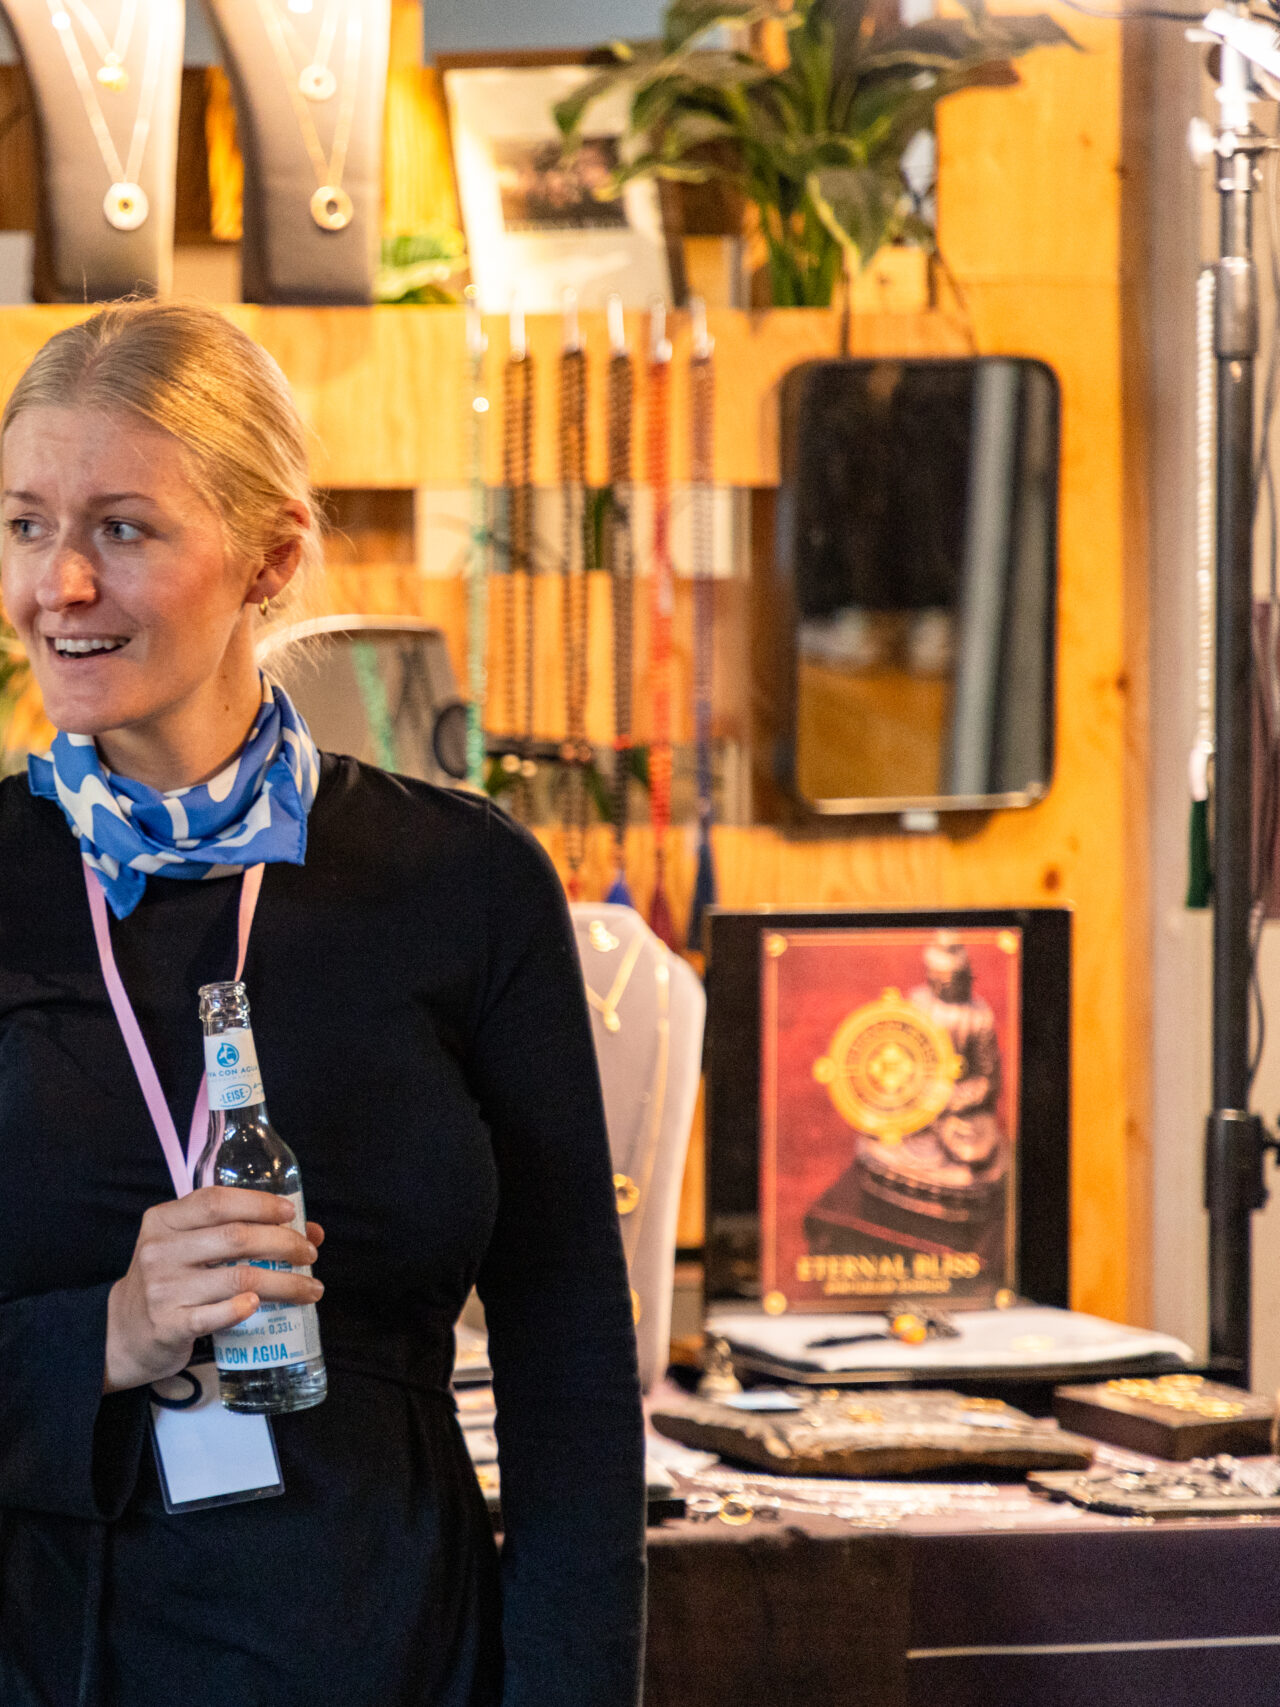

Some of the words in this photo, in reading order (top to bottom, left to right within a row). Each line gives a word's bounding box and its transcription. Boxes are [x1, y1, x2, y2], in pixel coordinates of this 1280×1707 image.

[218, 1069, 238, 1077] CON
[222, 1088, 246, 1104] LEISE
[796, 1253, 910, 1282] ETERNAL
[914, 1251, 981, 1280] BLISS
[225, 1347, 248, 1364] CON
[252, 1343, 288, 1364] AGUA
